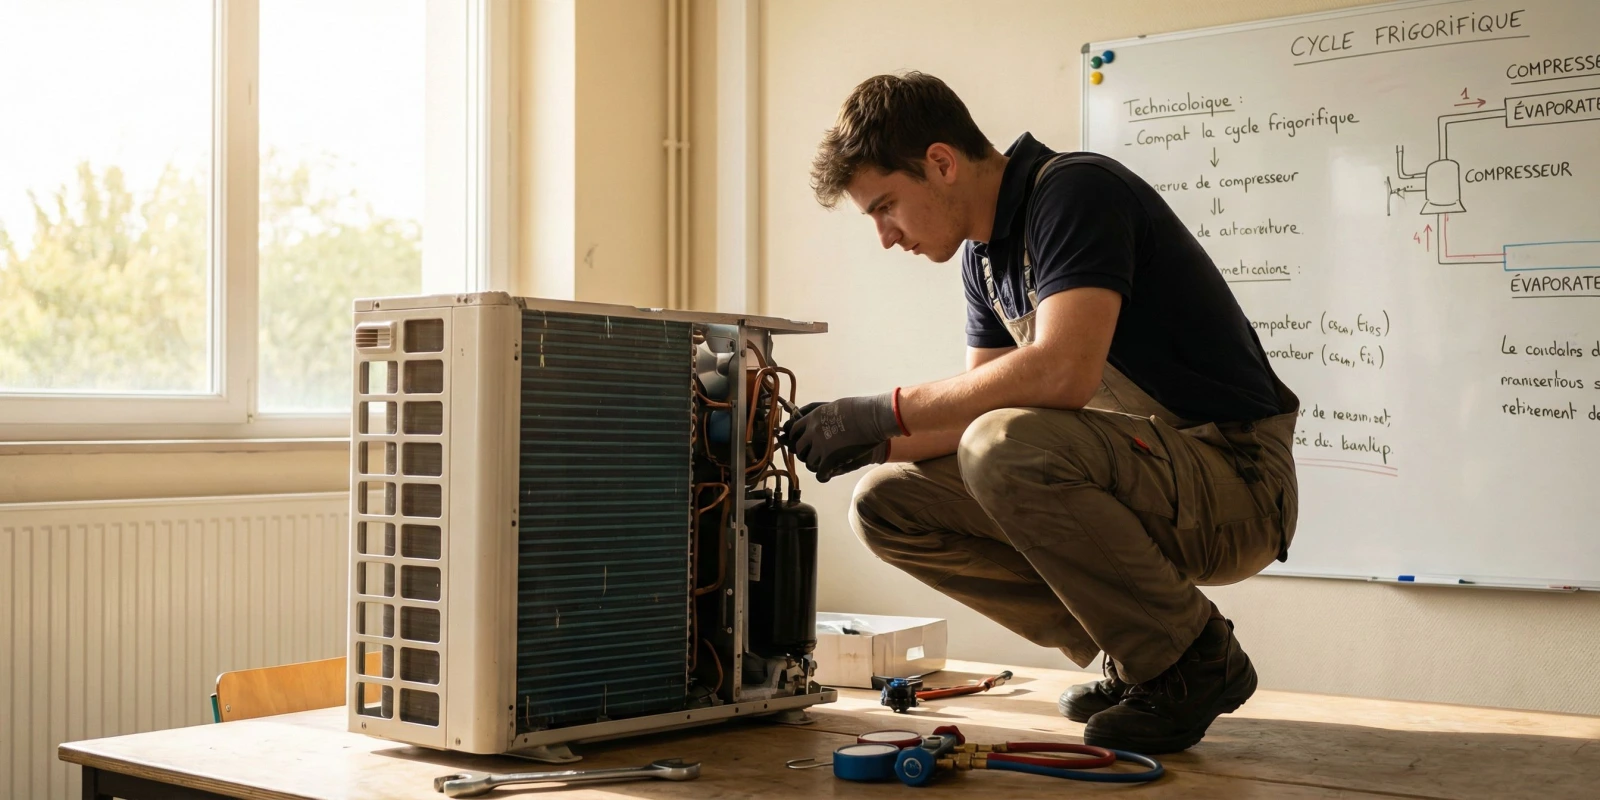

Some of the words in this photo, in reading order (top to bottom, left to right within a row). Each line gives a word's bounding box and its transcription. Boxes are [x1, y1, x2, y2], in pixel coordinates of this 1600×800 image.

[1290, 31, 1355, 57] CYCLE
[1460, 87, 1470, 100] 1
[1202, 122, 1216, 139] la
[1224, 117, 1260, 143] cycle
[1268, 107, 1360, 138] frigorifique
[1195, 174, 1212, 189] de
[1219, 171, 1300, 193] compresseur
[1465, 161, 1573, 184] COMPRESSEUR
[1197, 223, 1211, 238] de
[1413, 232, 1421, 244] 4
[1266, 343, 1314, 361] orateur
[1501, 334, 1518, 355] Le
[1312, 403, 1326, 420] de
